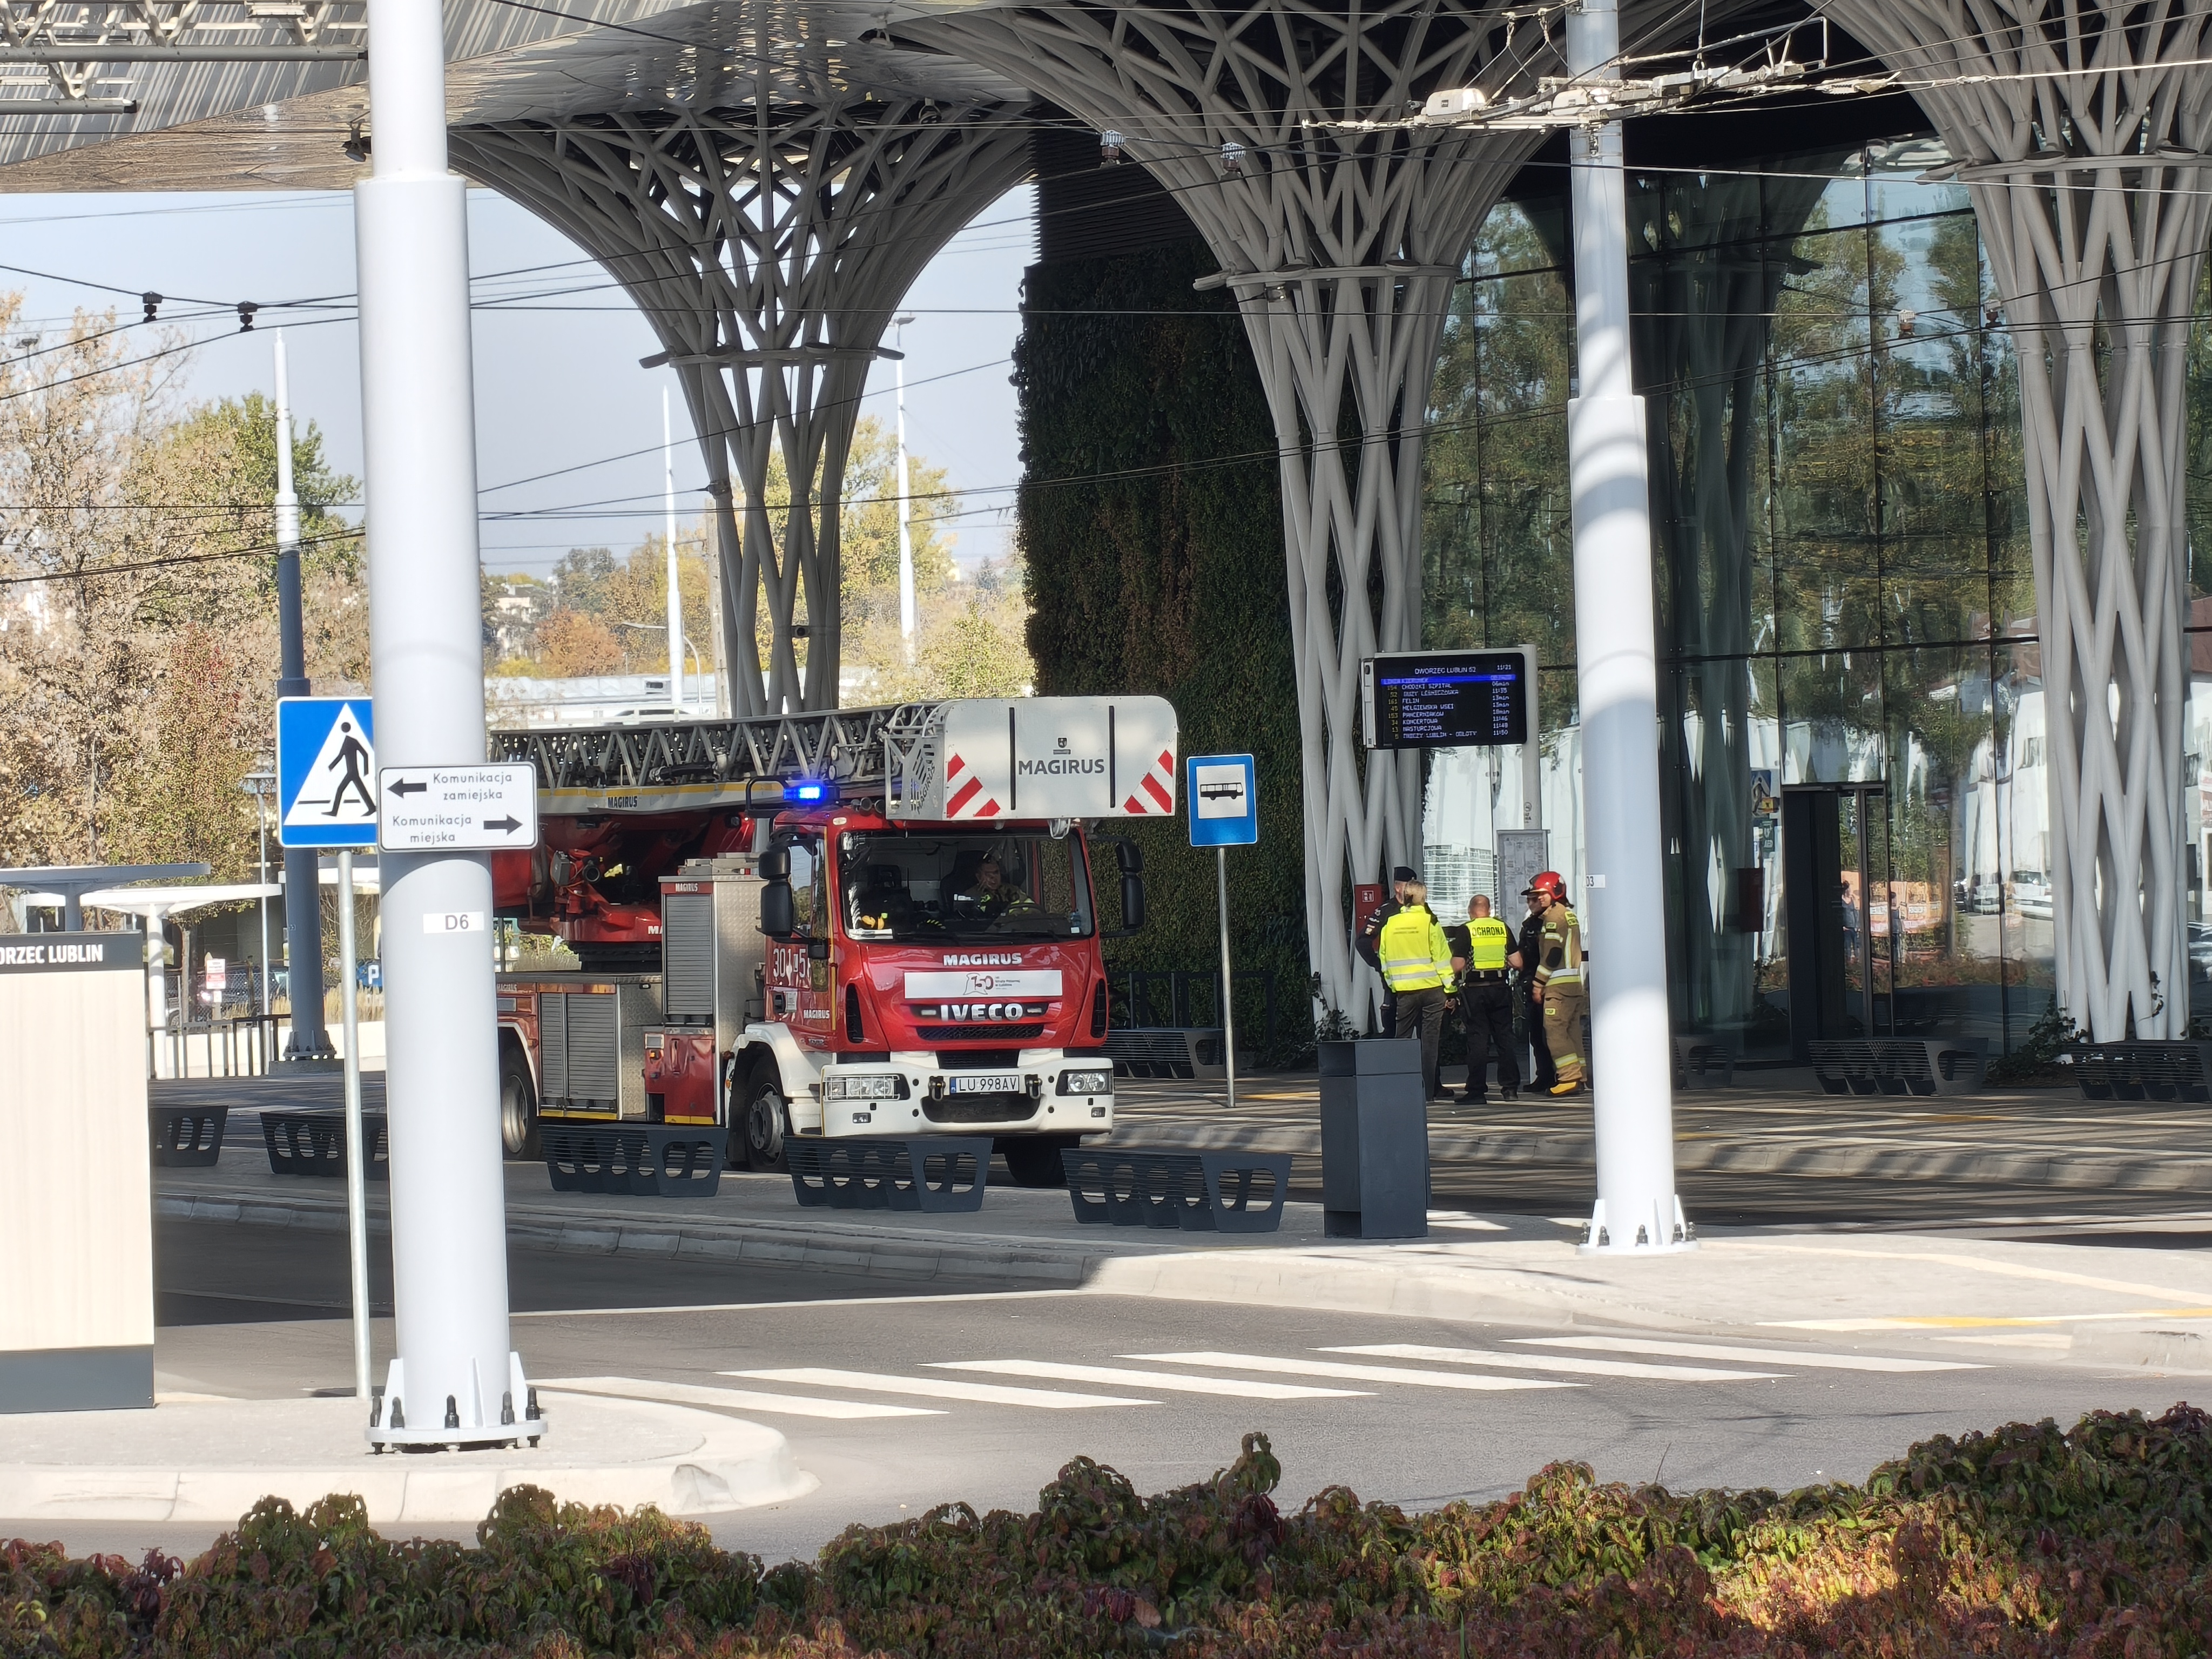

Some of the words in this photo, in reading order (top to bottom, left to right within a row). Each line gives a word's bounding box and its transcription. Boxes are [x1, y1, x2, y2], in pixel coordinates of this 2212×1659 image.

[1019, 759, 1105, 775] MAGIRUS
[433, 771, 512, 785] Komunikacja
[443, 788, 503, 802] zamiejska
[608, 795, 638, 808] MAGIRUS
[392, 814, 472, 827] Komunikacja
[409, 831, 456, 845] miejska
[675, 882, 698, 892] MAGIRUS
[444, 914, 469, 930] D6
[1472, 927, 1506, 936] OCHRONA
[48, 943, 103, 963] LUBLIN
[943, 953, 1023, 966] MAGIRUS
[803, 1009, 831, 1019] MAGIRUS
[940, 1003, 1024, 1022] IVECO
[959, 1078, 976, 1091] LU
[980, 1077, 1017, 1091] 998AV
